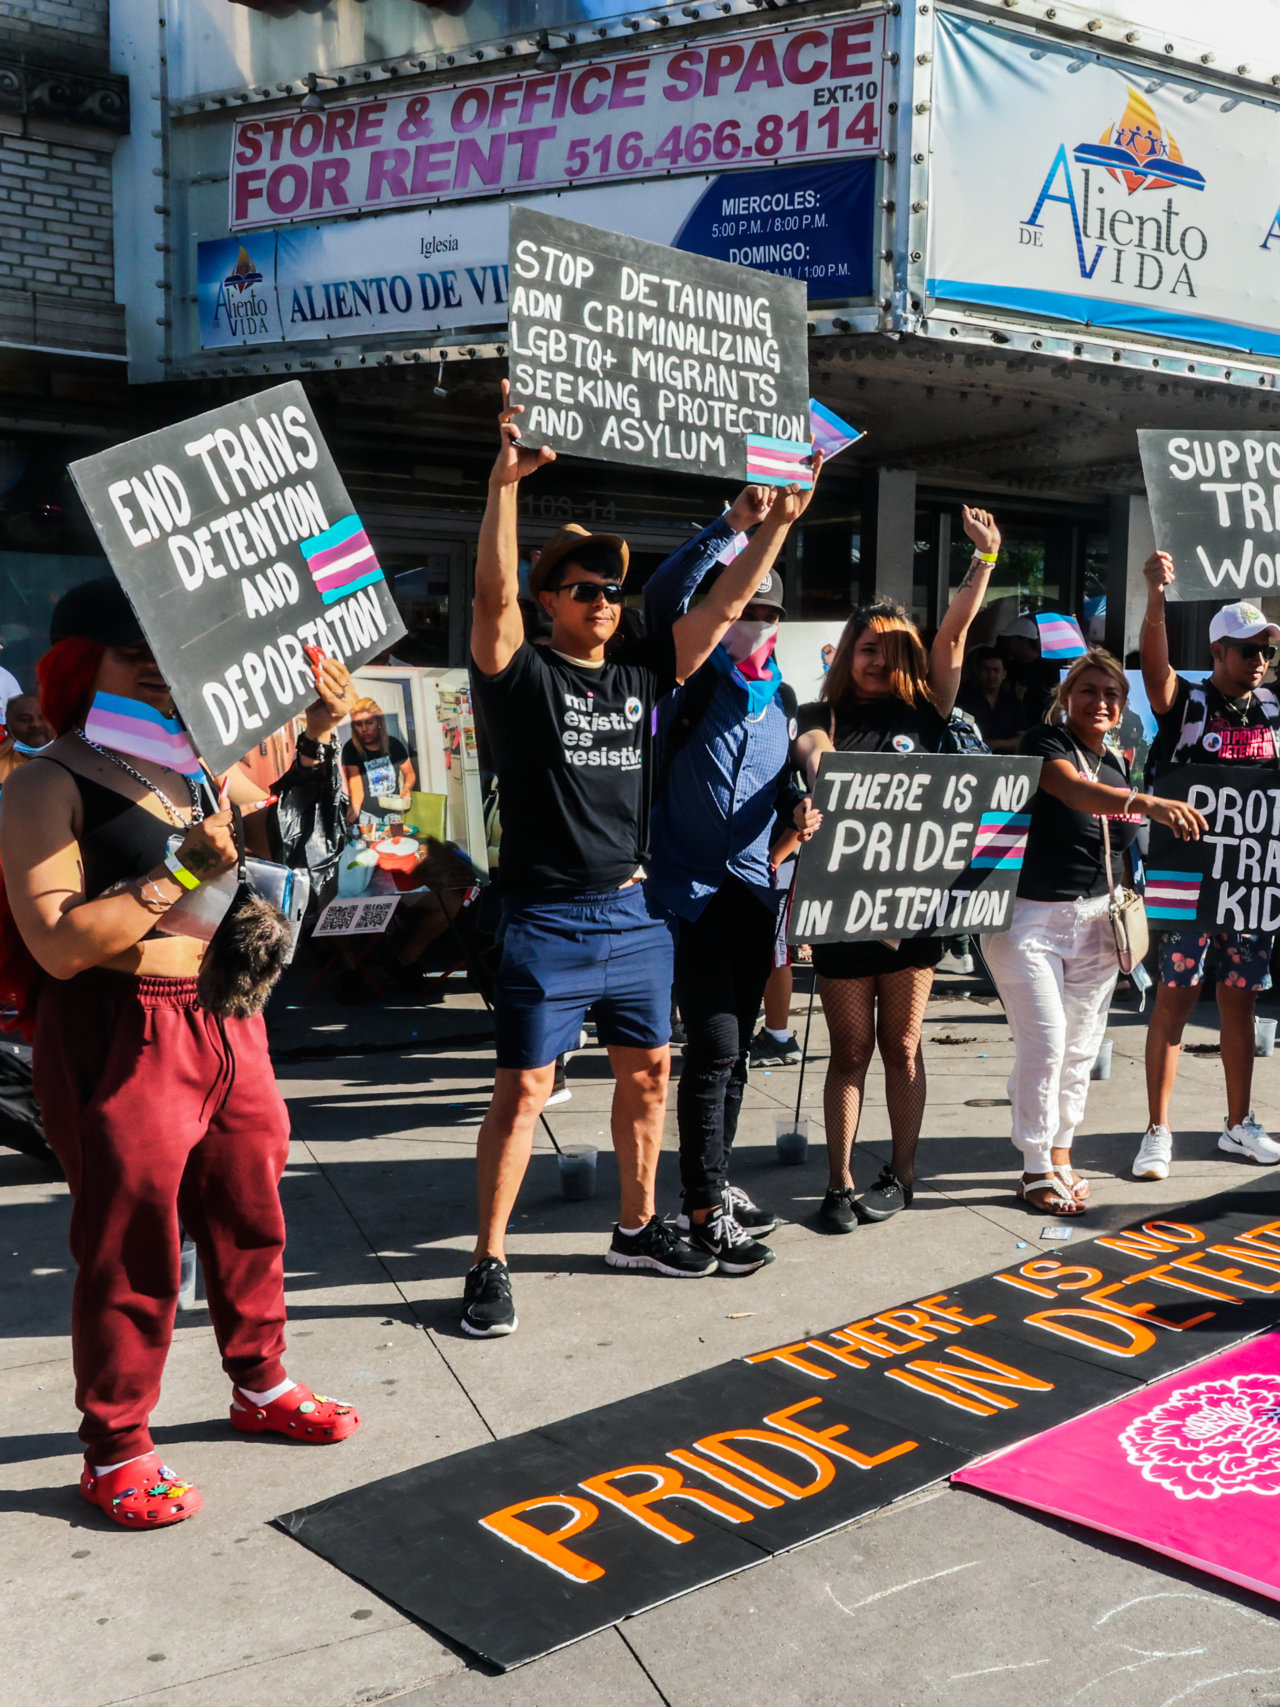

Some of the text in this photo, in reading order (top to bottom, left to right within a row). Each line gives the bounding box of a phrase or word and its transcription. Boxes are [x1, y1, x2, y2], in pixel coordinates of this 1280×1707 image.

[235, 21, 875, 166] STORE & OFFICE SPACE
[813, 81, 878, 107] EXT.10
[235, 102, 879, 220] FOR RENT 516.466.8114
[711, 213, 829, 238] 5:00 P.M. / 8:00 P.M.
[721, 190, 822, 217] MIERCOLES:
[1019, 142, 1208, 262] Aliento
[420, 234, 459, 259] Iglesia
[729, 242, 811, 265] DOMINGO:
[1019, 227, 1044, 248] DE
[290, 264, 509, 323] ALIENTO DE VI
[515, 240, 772, 338] STOP DETAINING
[804, 264, 826, 278] 1:00
[828, 263, 851, 276] P.M.
[1075, 245, 1198, 298] VIDA
[214, 281, 268, 320] Aliento
[229, 317, 269, 336] VIDA
[512, 286, 781, 374] ADN CRIMINALIZING
[511, 321, 778, 407] LGBTQ+ MIGRANTS
[515, 364, 805, 442] SEEKING PROTECTION
[528, 405, 726, 467] AND ASYLUM
[108, 405, 319, 548] END TRANS
[167, 480, 330, 592] DETENTION
[240, 562, 300, 619] AND
[202, 585, 388, 746] DEPORTATION
[563, 711, 634, 732] existi
[564, 691, 594, 712] mi
[562, 730, 594, 748] es
[1218, 741, 1275, 759] DETENTION
[1232, 728, 1263, 745] PRIDE
[824, 772, 1030, 813] THERE IS NO
[827, 819, 975, 872] PRIDE
[795, 886, 1010, 937] IN DETENTION
[743, 1219, 1208, 1381] THERE IS NO
[479, 1395, 919, 1584] PRIDE
[885, 1344, 1056, 1418] IN
